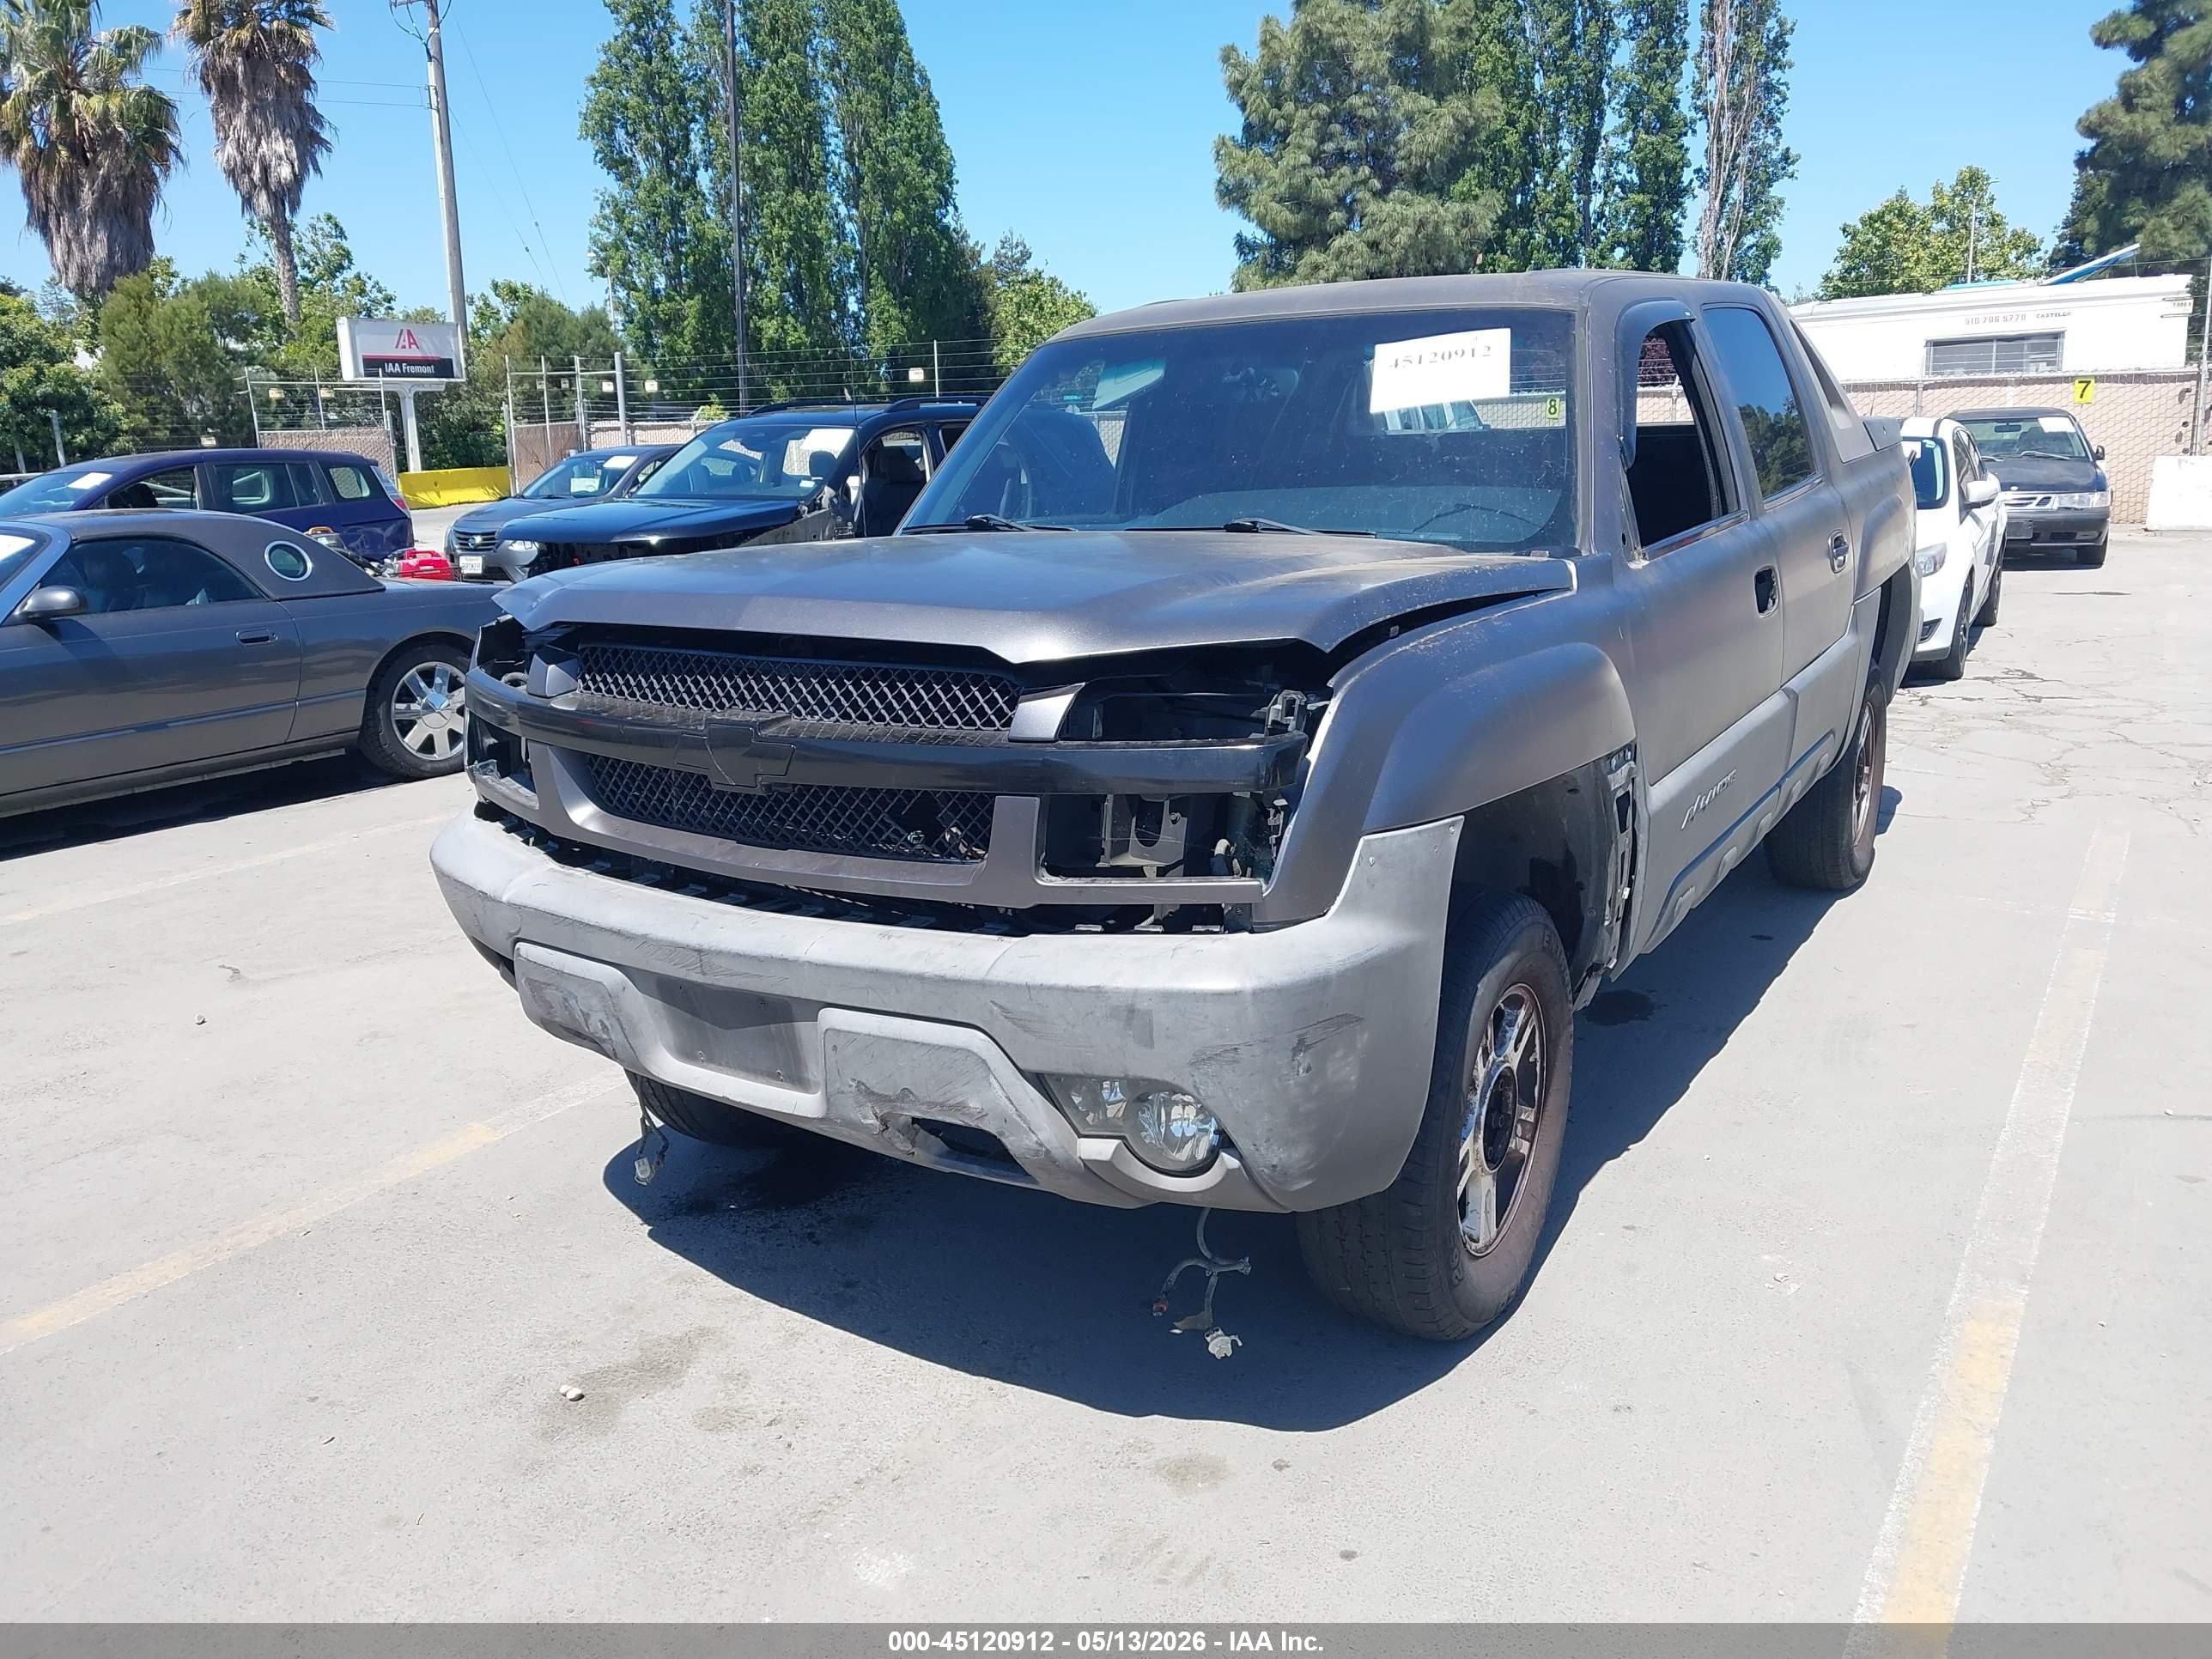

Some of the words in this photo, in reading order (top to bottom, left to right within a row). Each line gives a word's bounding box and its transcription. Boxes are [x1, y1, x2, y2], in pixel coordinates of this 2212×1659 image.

[1389, 345, 1492, 369] 45120912
[384, 362, 401, 374] IAA
[402, 362, 435, 374] Fremont
[2078, 380, 2092, 399] 7
[1547, 398, 1558, 416] 8
